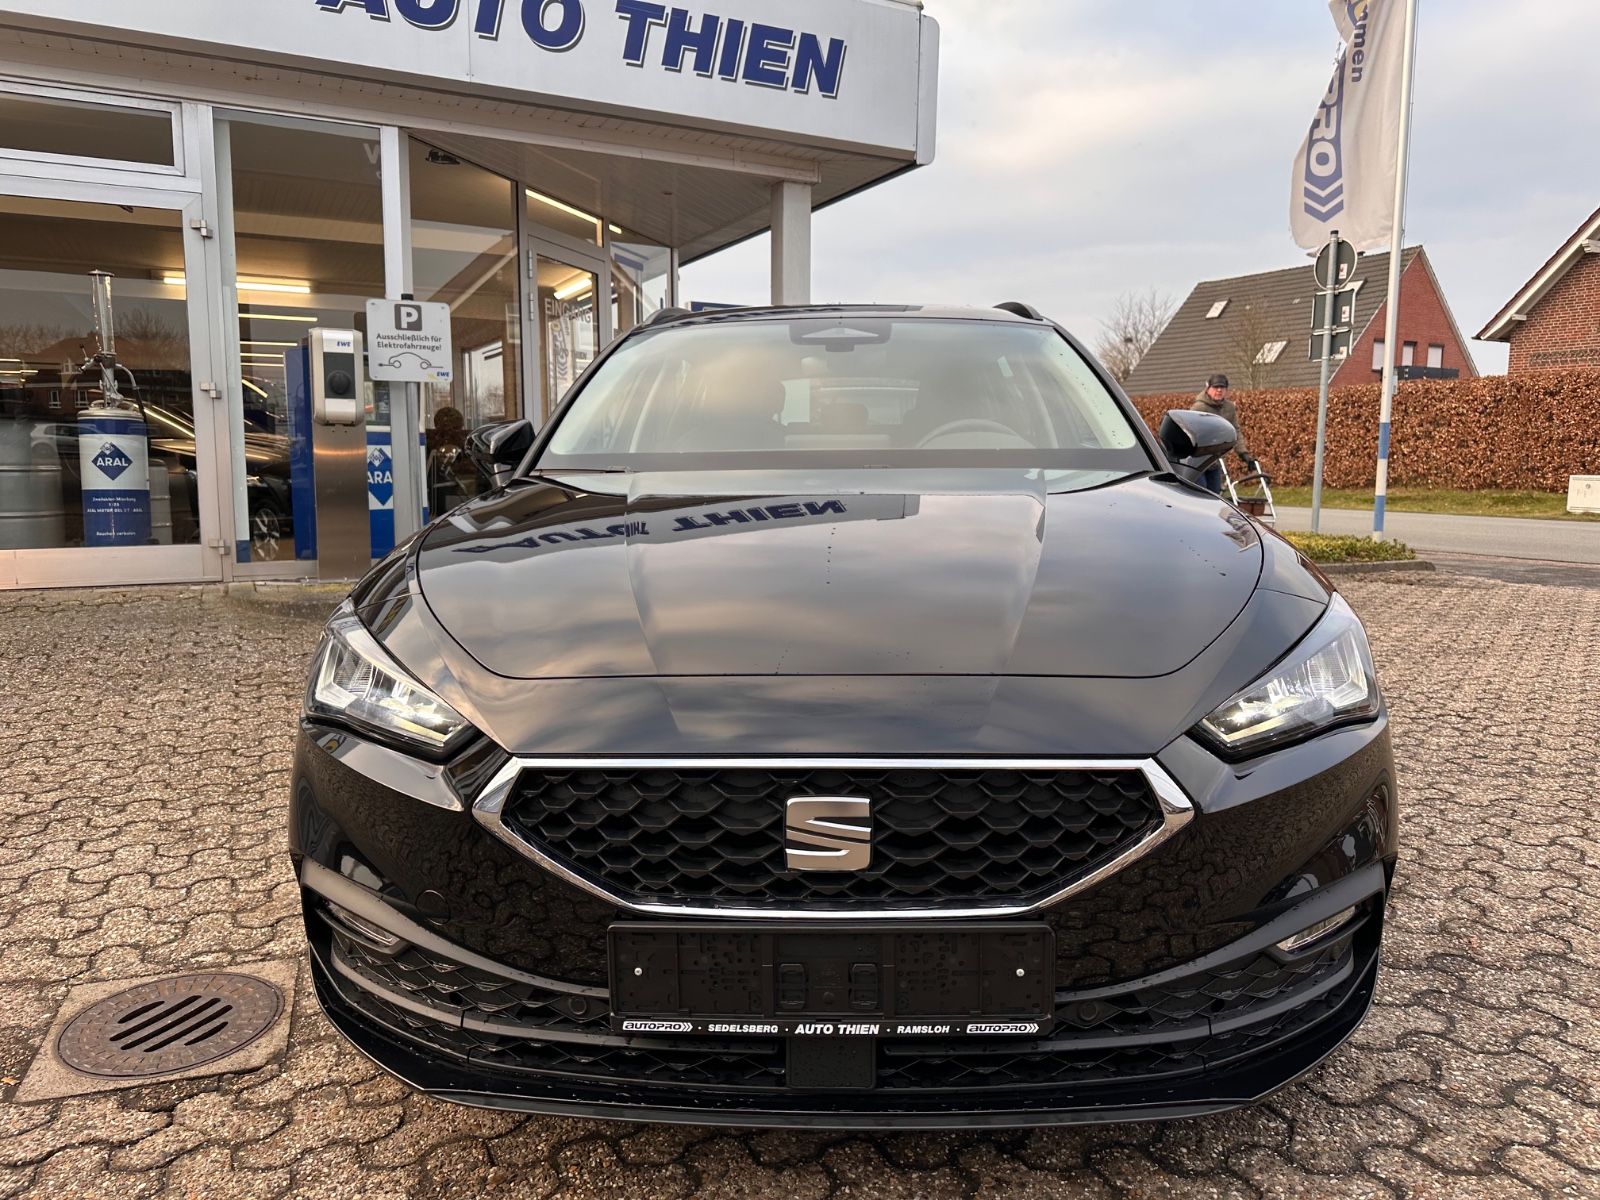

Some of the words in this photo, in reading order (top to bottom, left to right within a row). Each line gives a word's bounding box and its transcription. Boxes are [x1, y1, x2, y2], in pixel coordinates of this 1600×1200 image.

[315, 0, 585, 53] TO
[615, 0, 847, 99] THIEN
[376, 333, 430, 342] Ausschließlich
[377, 341, 442, 352] Elektrofahrzeuge!
[96, 457, 129, 467] ARAL
[707, 1023, 779, 1034] SEDELSBERG
[794, 1023, 834, 1035] AUTO
[837, 1024, 880, 1035] THIEN
[896, 1025, 951, 1034] RAMSLOH
